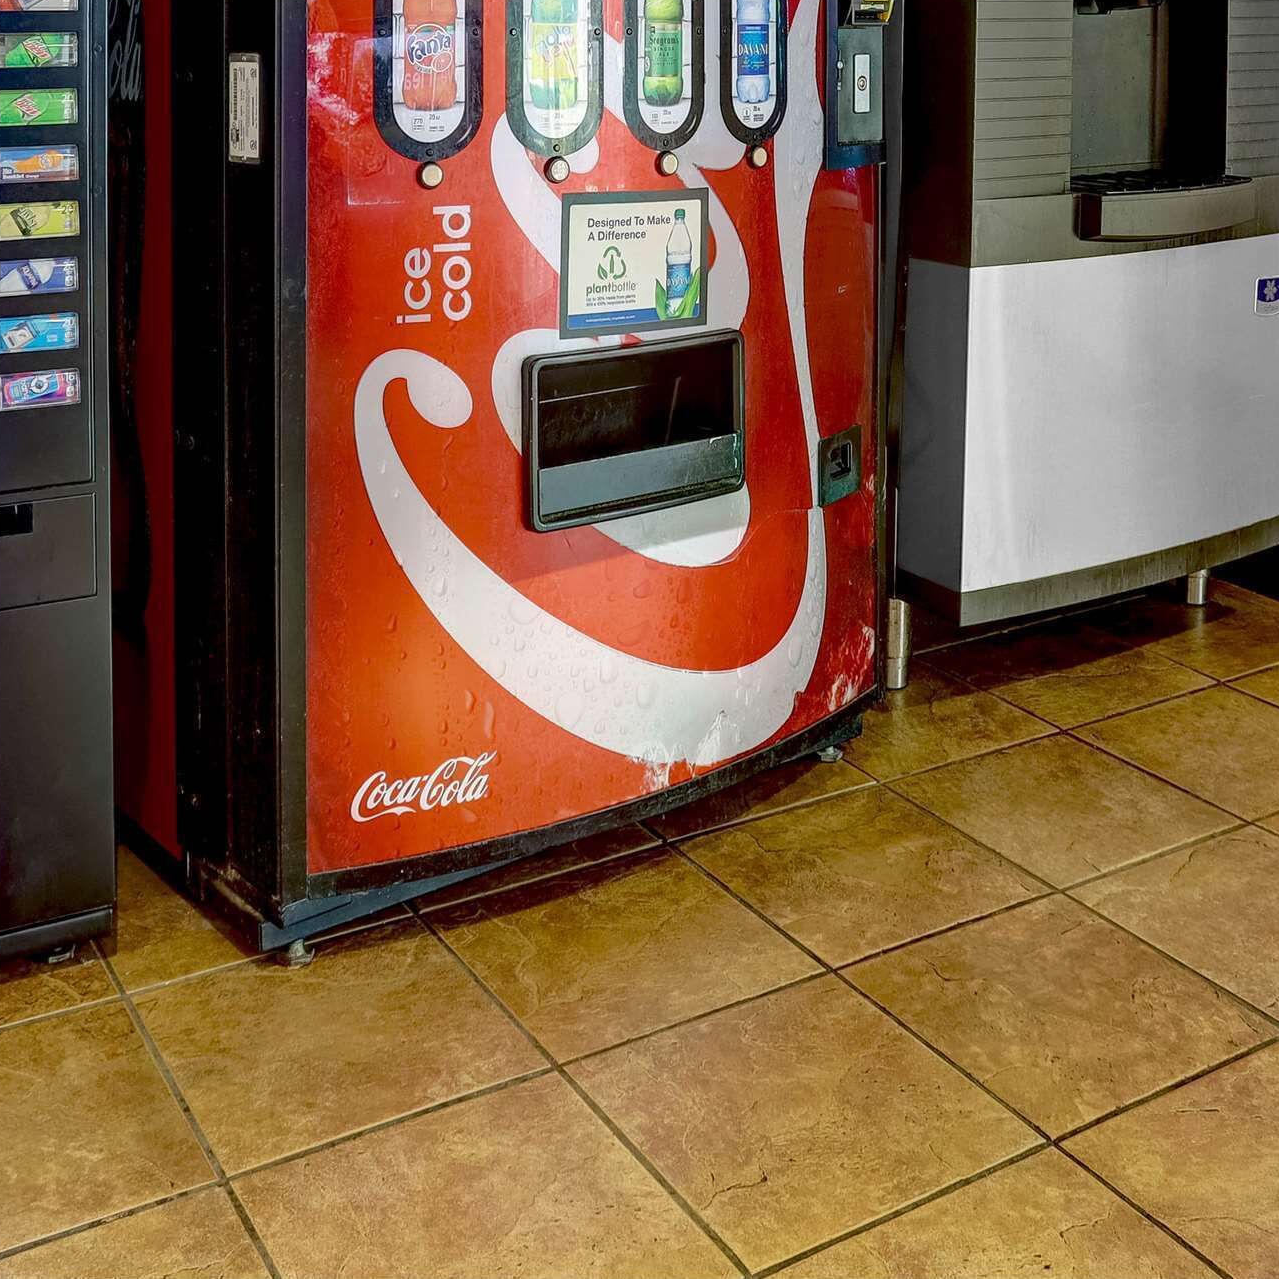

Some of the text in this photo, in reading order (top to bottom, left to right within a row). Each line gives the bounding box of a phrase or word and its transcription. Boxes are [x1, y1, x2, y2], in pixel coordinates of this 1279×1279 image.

[587, 230, 646, 241] A Difference
[588, 215, 671, 229] Designed To Make
[432, 205, 472, 321] cold
[396, 247, 432, 324] ice
[586, 280, 636, 296] plantbottle
[350, 750, 498, 823] Coca-Cola
